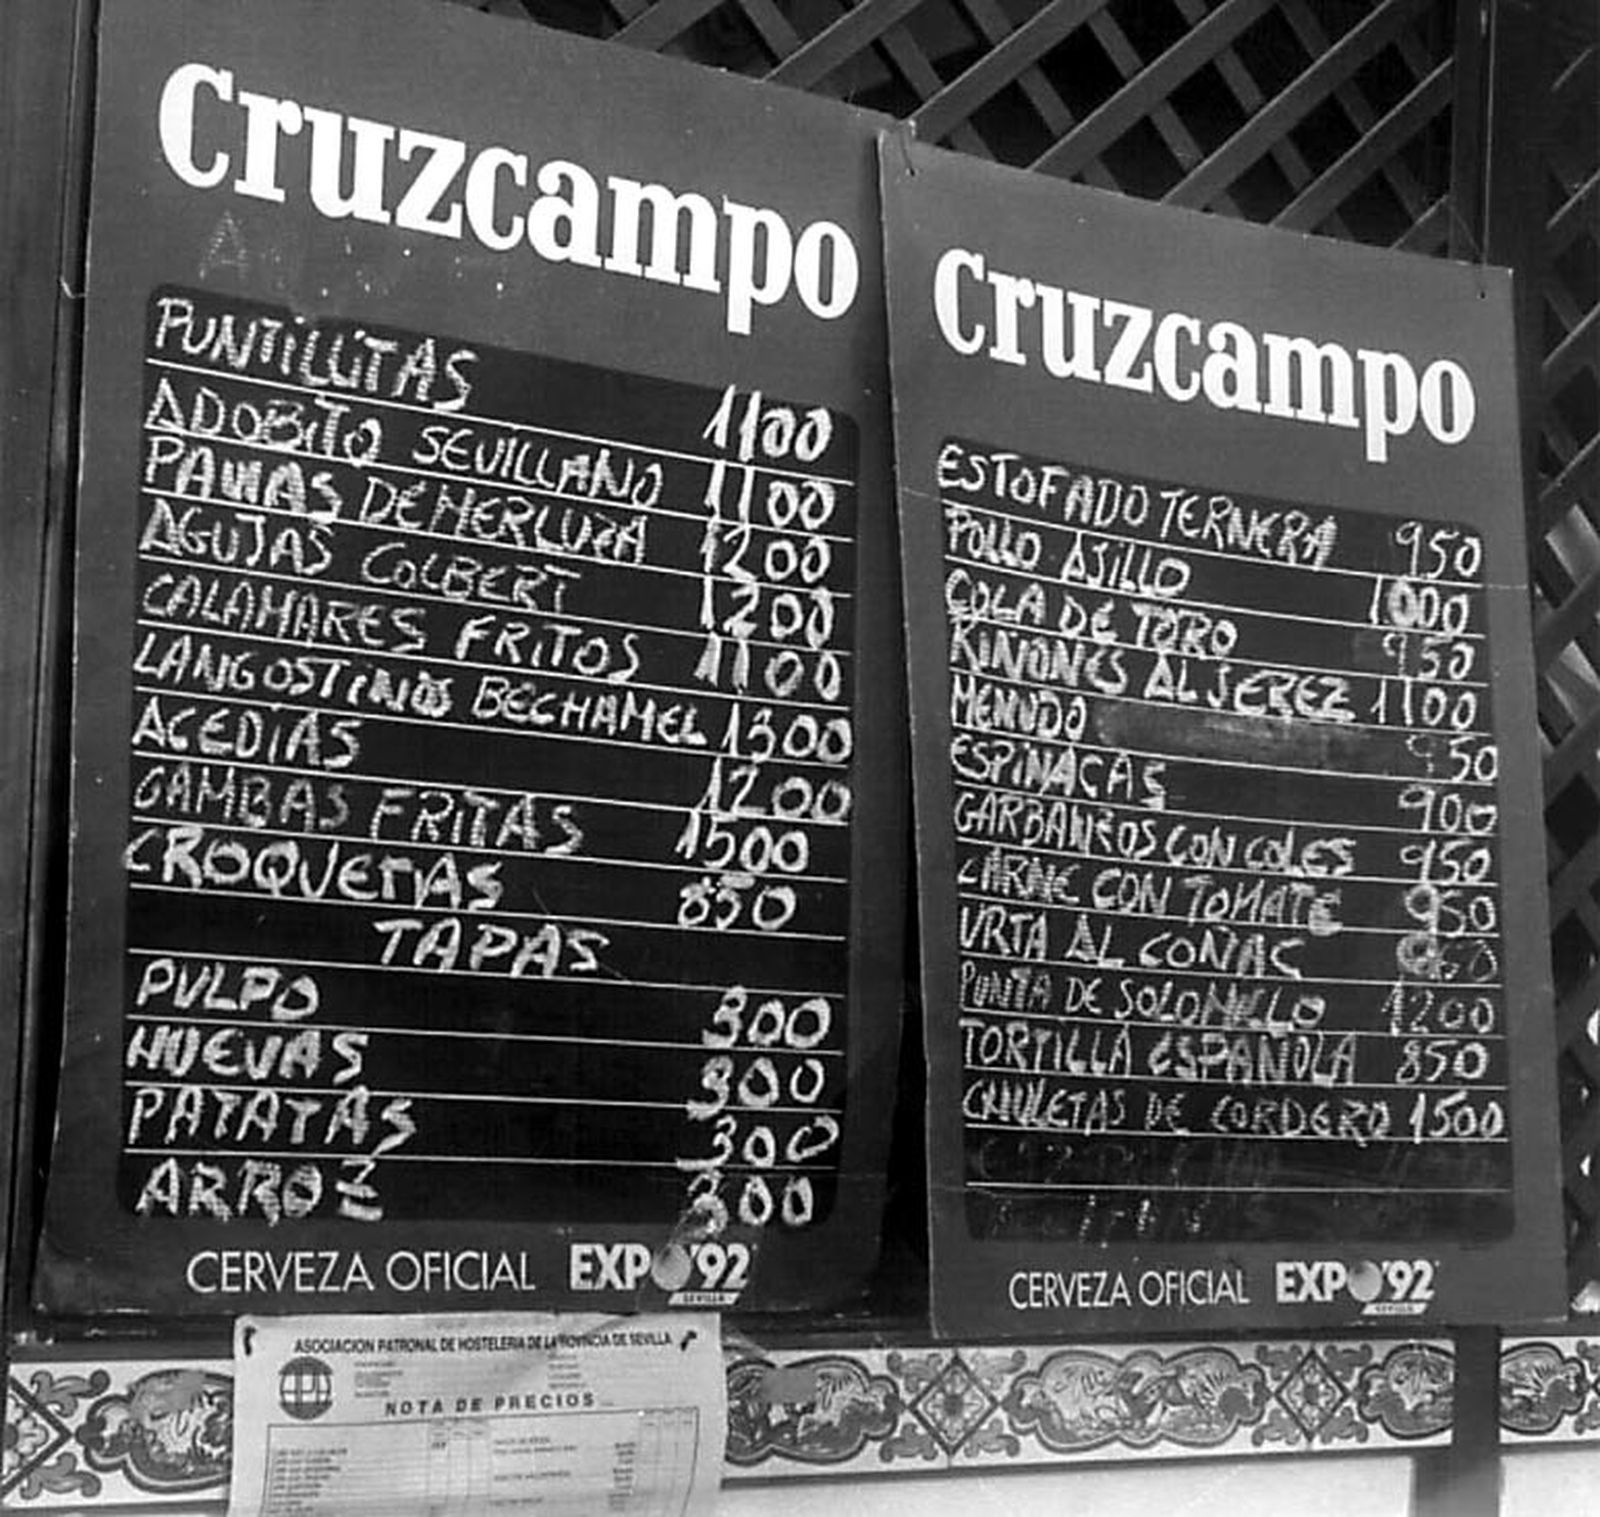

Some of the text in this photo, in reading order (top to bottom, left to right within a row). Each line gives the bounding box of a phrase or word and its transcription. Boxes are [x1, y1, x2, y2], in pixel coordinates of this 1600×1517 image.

[158, 62, 858, 334] Cruzcampo
[156, 297, 832, 462] PUNTILLITAS 1100
[934, 248, 1476, 462] Cruzcampo
[144, 378, 835, 530] ADOBITO SEVILLANO 1100
[360, 477, 424, 530] DE
[700, 515, 830, 584] 1200
[938, 444, 1482, 580] ESTOFADO TERNERA 950
[138, 498, 334, 576] AGUJAS
[701, 576, 834, 648] 1200
[945, 507, 1470, 636] POLLO AJILLO 1000
[143, 573, 841, 702] CALAMARES FRITOS 1100
[945, 568, 1476, 681] COLA DE TORO 950
[472, 675, 708, 745] BECHAMEL
[722, 702, 852, 763] 1300
[950, 675, 1088, 742] MENUDO
[1144, 650, 1199, 703] AL
[1207, 662, 1357, 725] JEREZ
[1370, 676, 1478, 731] 1100
[132, 696, 851, 822] ACEDIAS 1200
[950, 734, 1499, 834] ESPINACAS 900
[134, 765, 809, 874] GAMBAS FRITAS 1500
[1165, 825, 1237, 869] CON
[1399, 838, 1492, 884] 950
[123, 824, 503, 912] CROQUETAS
[1092, 867, 1173, 914] CON
[1183, 873, 1344, 937] TOMATE
[1403, 883, 1496, 937] 950
[373, 917, 610, 978] TAPAS
[1065, 914, 1126, 968] AL
[136, 957, 320, 1021] PULPO
[960, 959, 1051, 1013] PUNTA
[1065, 976, 1103, 1014] DE
[1380, 974, 1495, 1036] 1200
[126, 1024, 369, 1085] HUEVAS
[958, 1018, 1132, 1078] TORTILLA
[1396, 1038, 1489, 1084] 850
[129, 1086, 839, 1171] PATATAS 300
[1144, 1091, 1190, 1136] DE
[1211, 1095, 1391, 1147] CORDERO
[1408, 1090, 1504, 1144] 1500
[135, 1158, 383, 1227] ARROZ
[186, 1250, 376, 1294] CERVEZA
[385, 1250, 536, 1292] OFICIAL
[1008, 1270, 1132, 1311] CERVEZA
[1138, 1269, 1251, 1308] OFICIAL
[384, 1392, 596, 1416] NOTA DE PRECIOS
